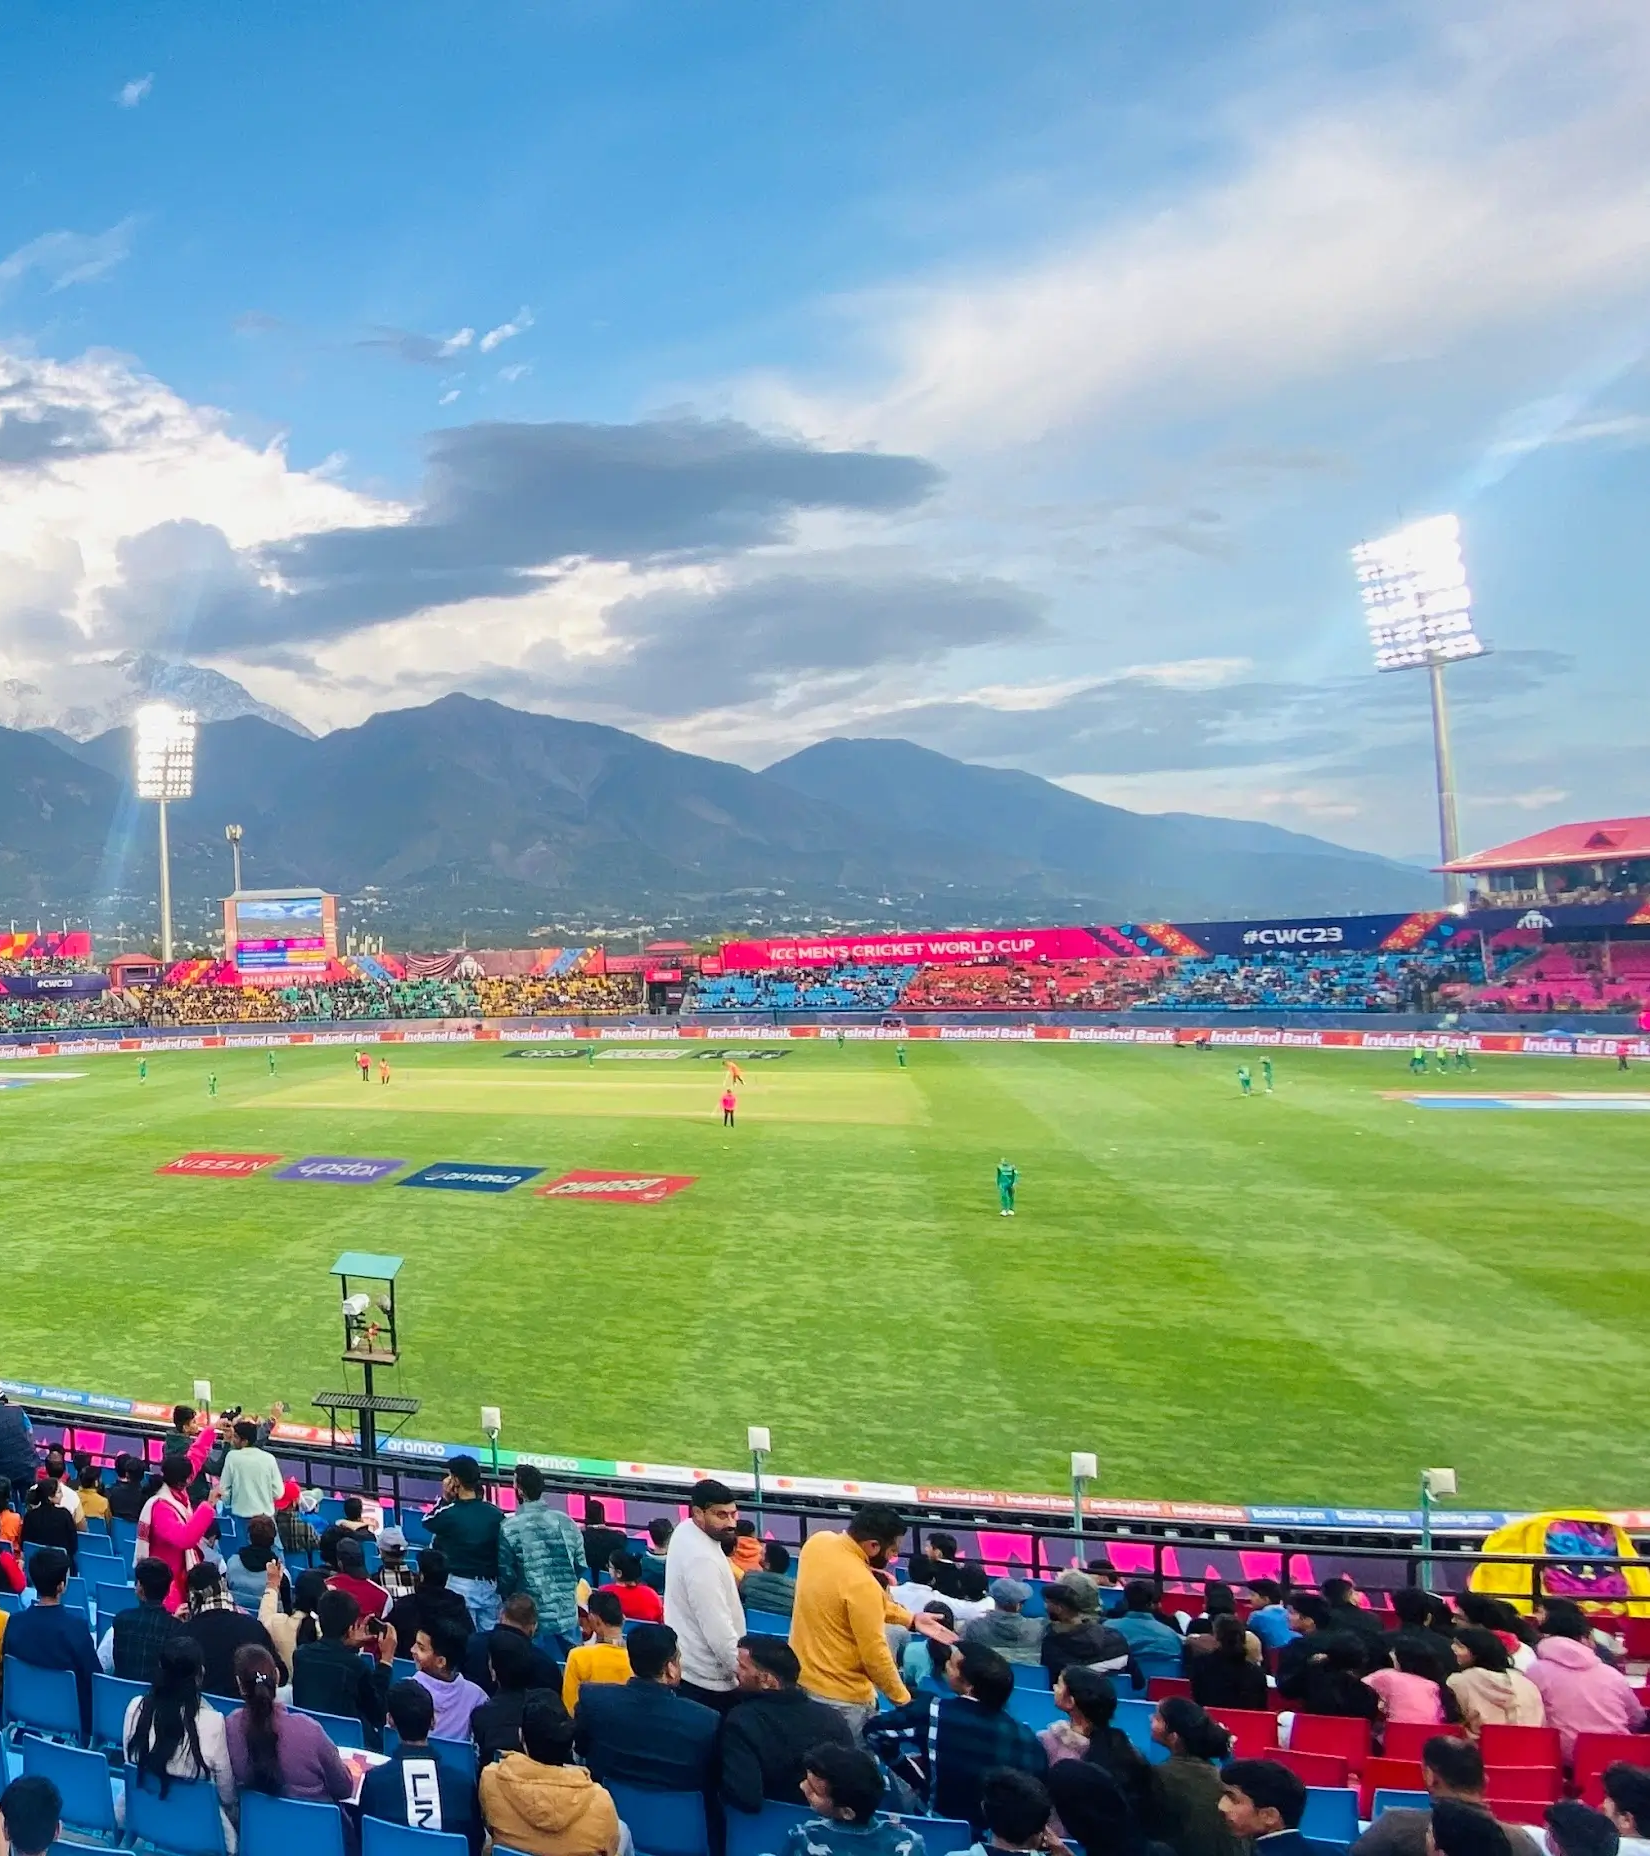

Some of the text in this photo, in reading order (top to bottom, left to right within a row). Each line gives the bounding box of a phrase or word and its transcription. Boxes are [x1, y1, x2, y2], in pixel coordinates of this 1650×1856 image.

[1242, 926, 1343, 945] #CWC23
[769, 938, 1036, 961] ICC MEN'S CRICKET WORLD CUP
[36, 979, 73, 989] #CWC23
[313, 1030, 381, 1044] IndusInd Bank
[403, 1030, 476, 1042] IndusInd Bank
[548, 1029, 576, 1040] Bank
[600, 1028, 681, 1040] IndusInd Bank
[707, 1026, 792, 1039] IndusInd Bank
[876, 1027, 910, 1039] Bank
[940, 1027, 1035, 1040] IndusInd Bank
[1069, 1028, 1175, 1042] IndusInd Bank
[1210, 1030, 1323, 1045] IndusInd Bank
[141, 1036, 204, 1050] IndusInd Bank
[225, 1033, 292, 1047] IndusInd Bank
[17, 1045, 39, 1058] Bank
[59, 1040, 120, 1055] IndusInd Bank
[168, 1158, 268, 1171] NISSAN
[297, 1162, 386, 1177] upstox
[387, 1437, 446, 1456] aramco
[516, 1453, 580, 1471] aramco
[1251, 1508, 1326, 1522] Booking.com
